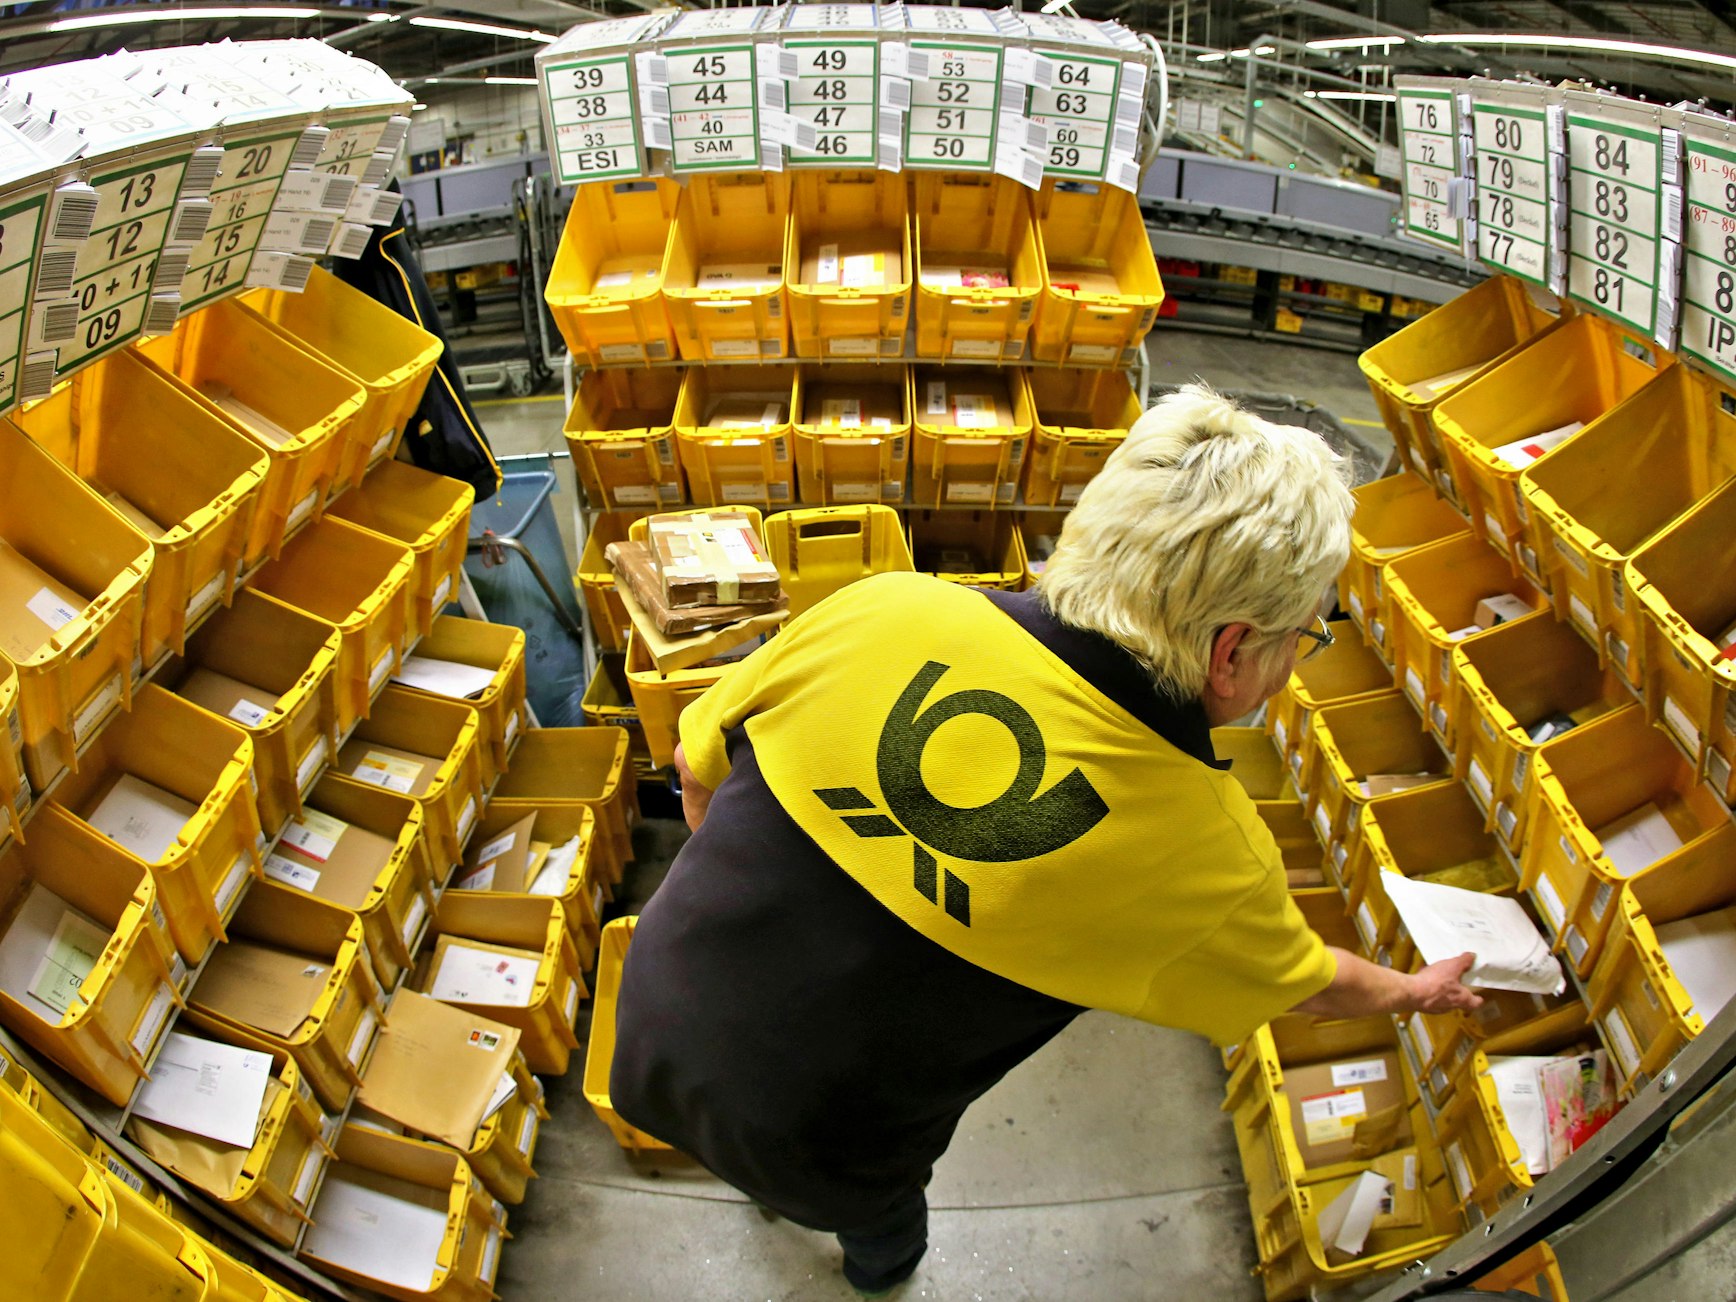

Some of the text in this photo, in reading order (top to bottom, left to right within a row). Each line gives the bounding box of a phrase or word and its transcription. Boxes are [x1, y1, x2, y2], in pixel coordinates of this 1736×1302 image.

[692, 56, 726, 76] 45
[813, 50, 847, 70] 49
[942, 62, 965, 77] 53
[573, 68, 604, 90] 39
[1059, 64, 1090, 86] 64
[695, 84, 728, 105] 44
[813, 80, 847, 101] 48
[937, 82, 970, 103] 52
[577, 96, 607, 118] 38
[1056, 93, 1087, 114] 63
[814, 107, 847, 127] 47
[936, 109, 966, 130] 51
[1416, 103, 1437, 129] 76
[702, 120, 723, 134] 40
[1057, 128, 1078, 144] 60
[1495, 118, 1521, 151] 80
[336, 139, 358, 161] 31
[584, 132, 605, 147] 33
[694, 140, 733, 153] SAM
[816, 135, 848, 155] 46
[933, 137, 964, 158] 50
[236, 145, 272, 179] 20
[578, 150, 618, 171] ESI
[1050, 146, 1080, 167] 59
[1421, 145, 1435, 163] 72
[1595, 134, 1630, 176] 84
[1689, 155, 1706, 173] (91
[1488, 155, 1514, 189] 79
[120, 173, 156, 212] 13
[1424, 179, 1438, 198] 70
[229, 201, 247, 221] 16
[1488, 193, 1514, 228] 78
[1595, 181, 1628, 223] 83
[1425, 212, 1439, 230] 65
[1689, 206, 1708, 224] (87
[107, 221, 143, 260] 12
[214, 224, 244, 256] 15
[1489, 231, 1514, 265] 77
[1595, 225, 1628, 269] 82
[72, 259, 157, 311] 0 + 11
[203, 260, 231, 292] 14
[1594, 268, 1624, 312] 81
[86, 309, 121, 349] 09
[1708, 316, 1736, 353] IP
